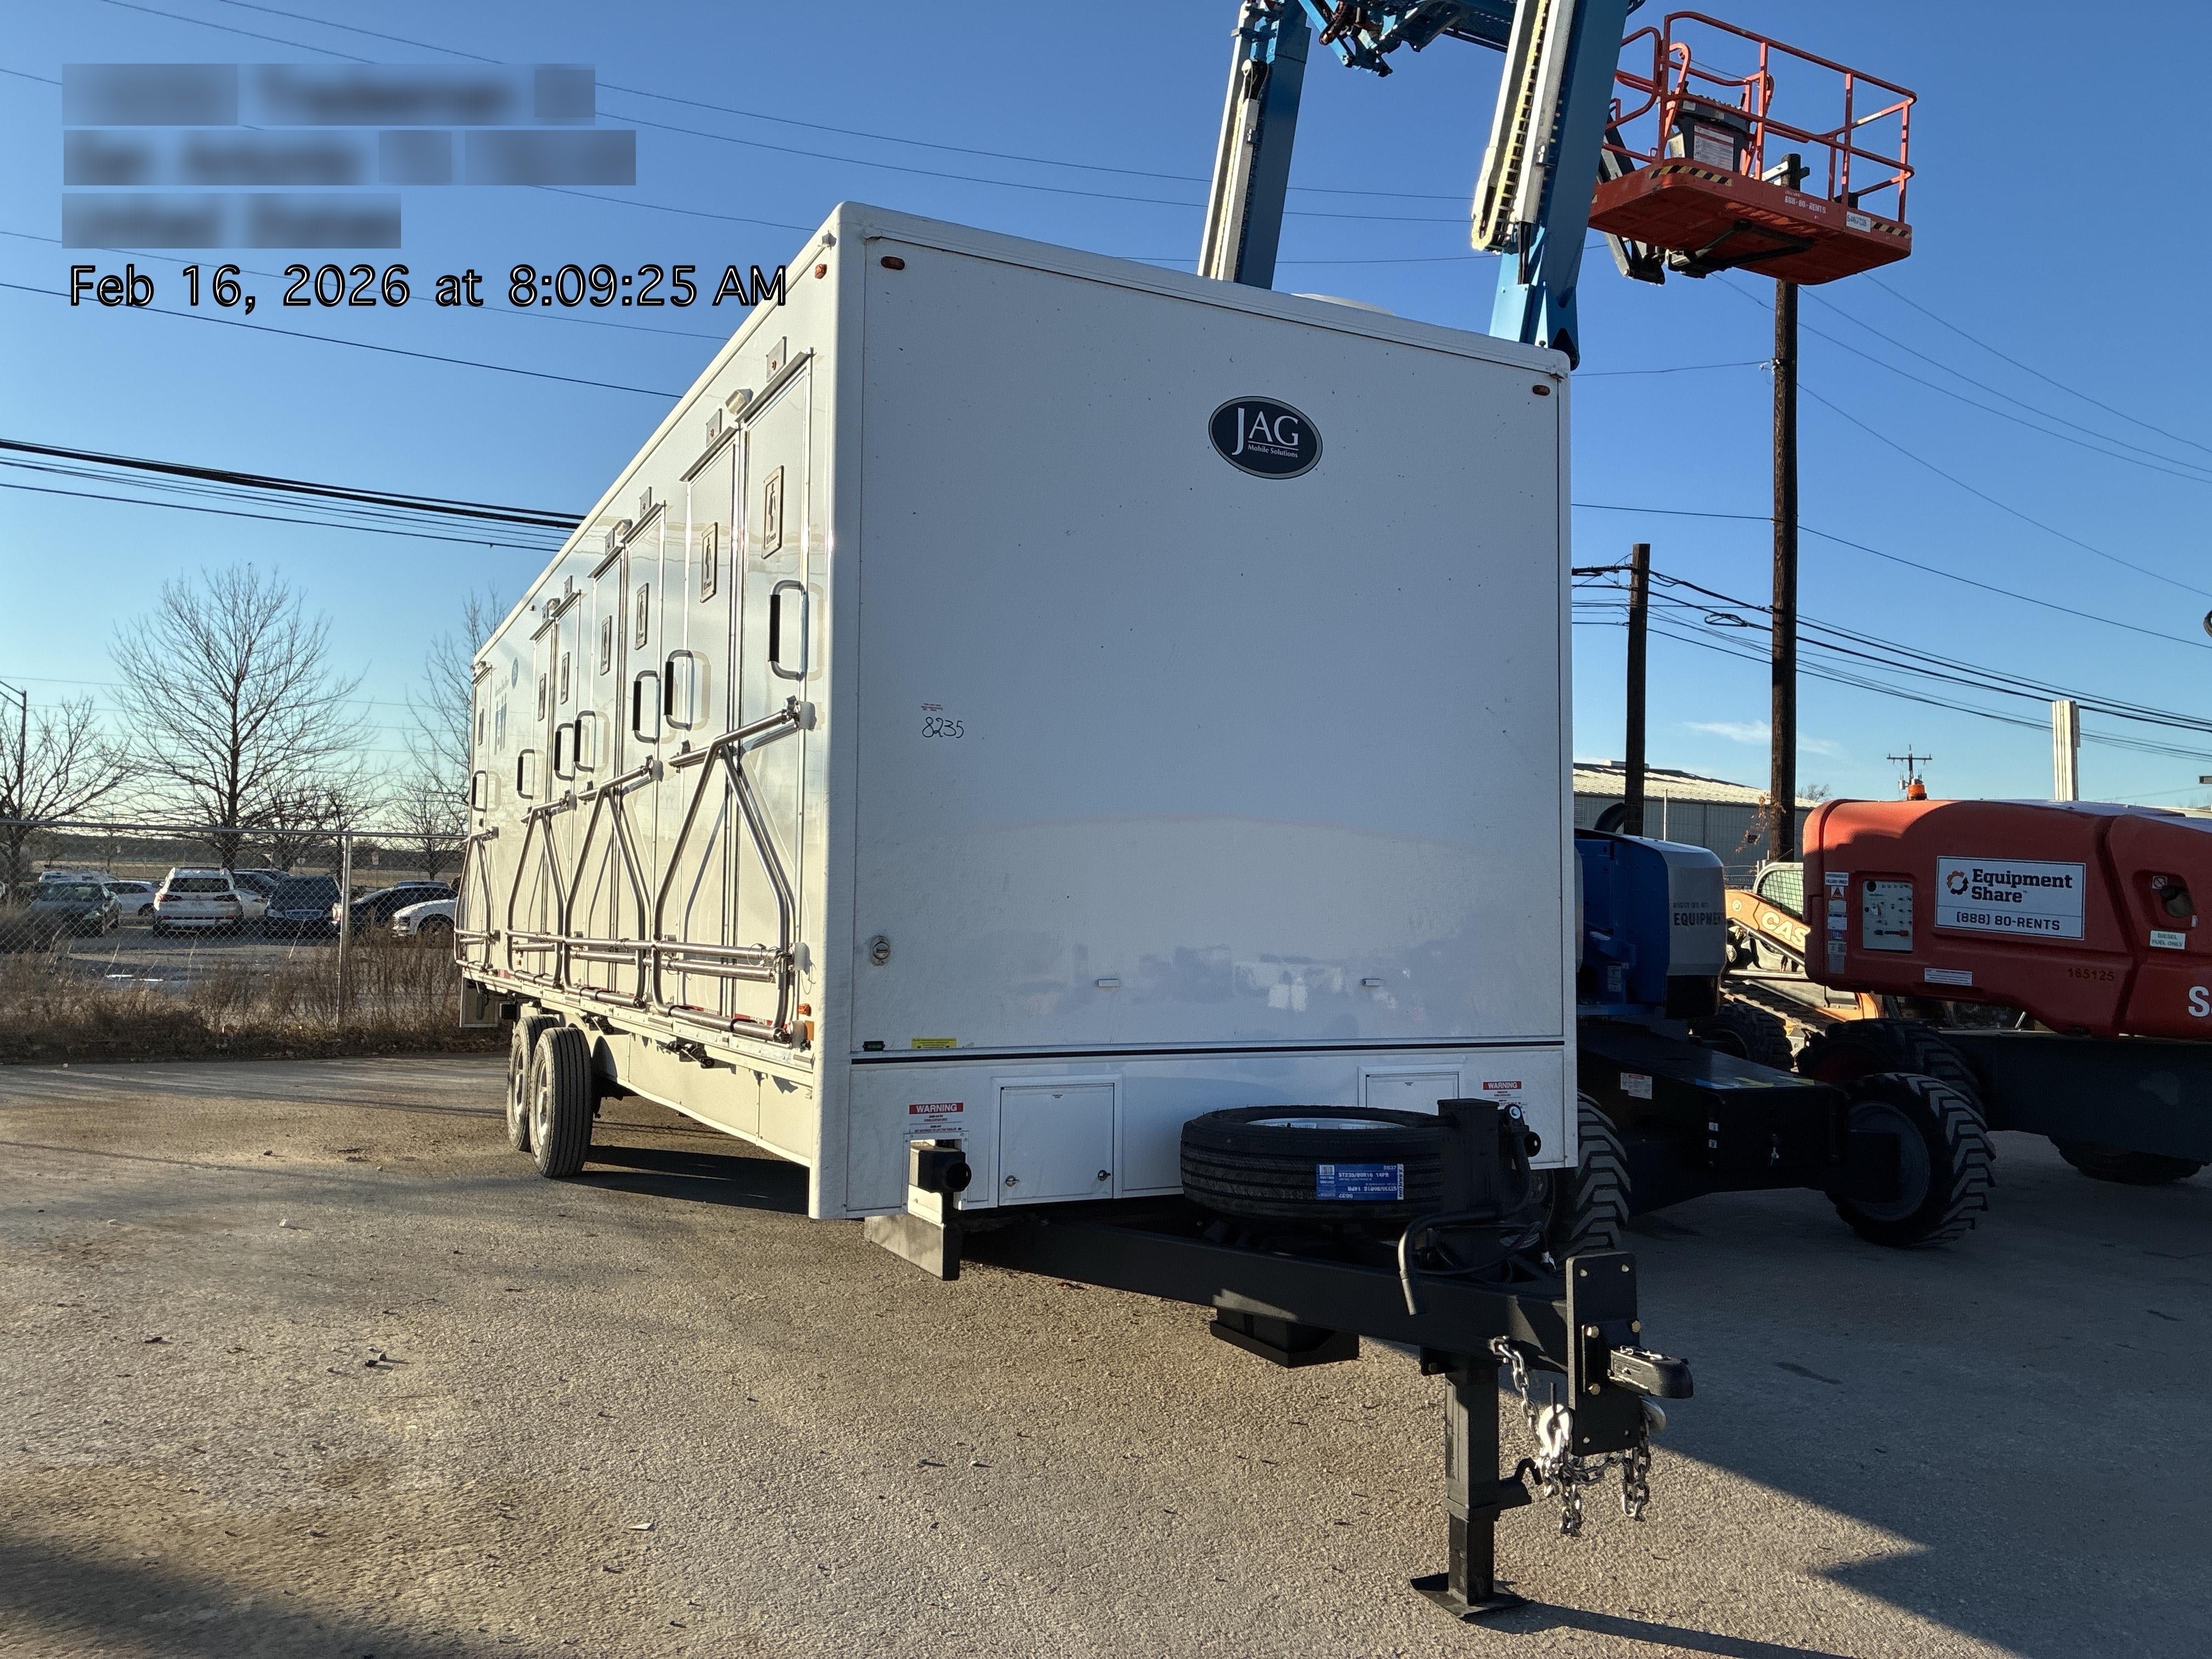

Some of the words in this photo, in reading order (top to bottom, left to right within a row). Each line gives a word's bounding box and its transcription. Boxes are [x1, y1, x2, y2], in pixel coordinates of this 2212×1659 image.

[1232, 407, 1299, 455] JAG
[1248, 443, 1269, 454] Mobile
[1270, 448, 1299, 459] Solutions
[922, 716, 964, 738] 8235
[1972, 868, 2073, 889] Equipment
[1971, 886, 2023, 903] Share
[1956, 911, 1990, 926] (888)
[1995, 915, 2060, 930] 80-RENTS
[2067, 967, 2115, 981] 165125
[2188, 986, 2212, 1017] S
[916, 1103, 957, 1113] WARNING
